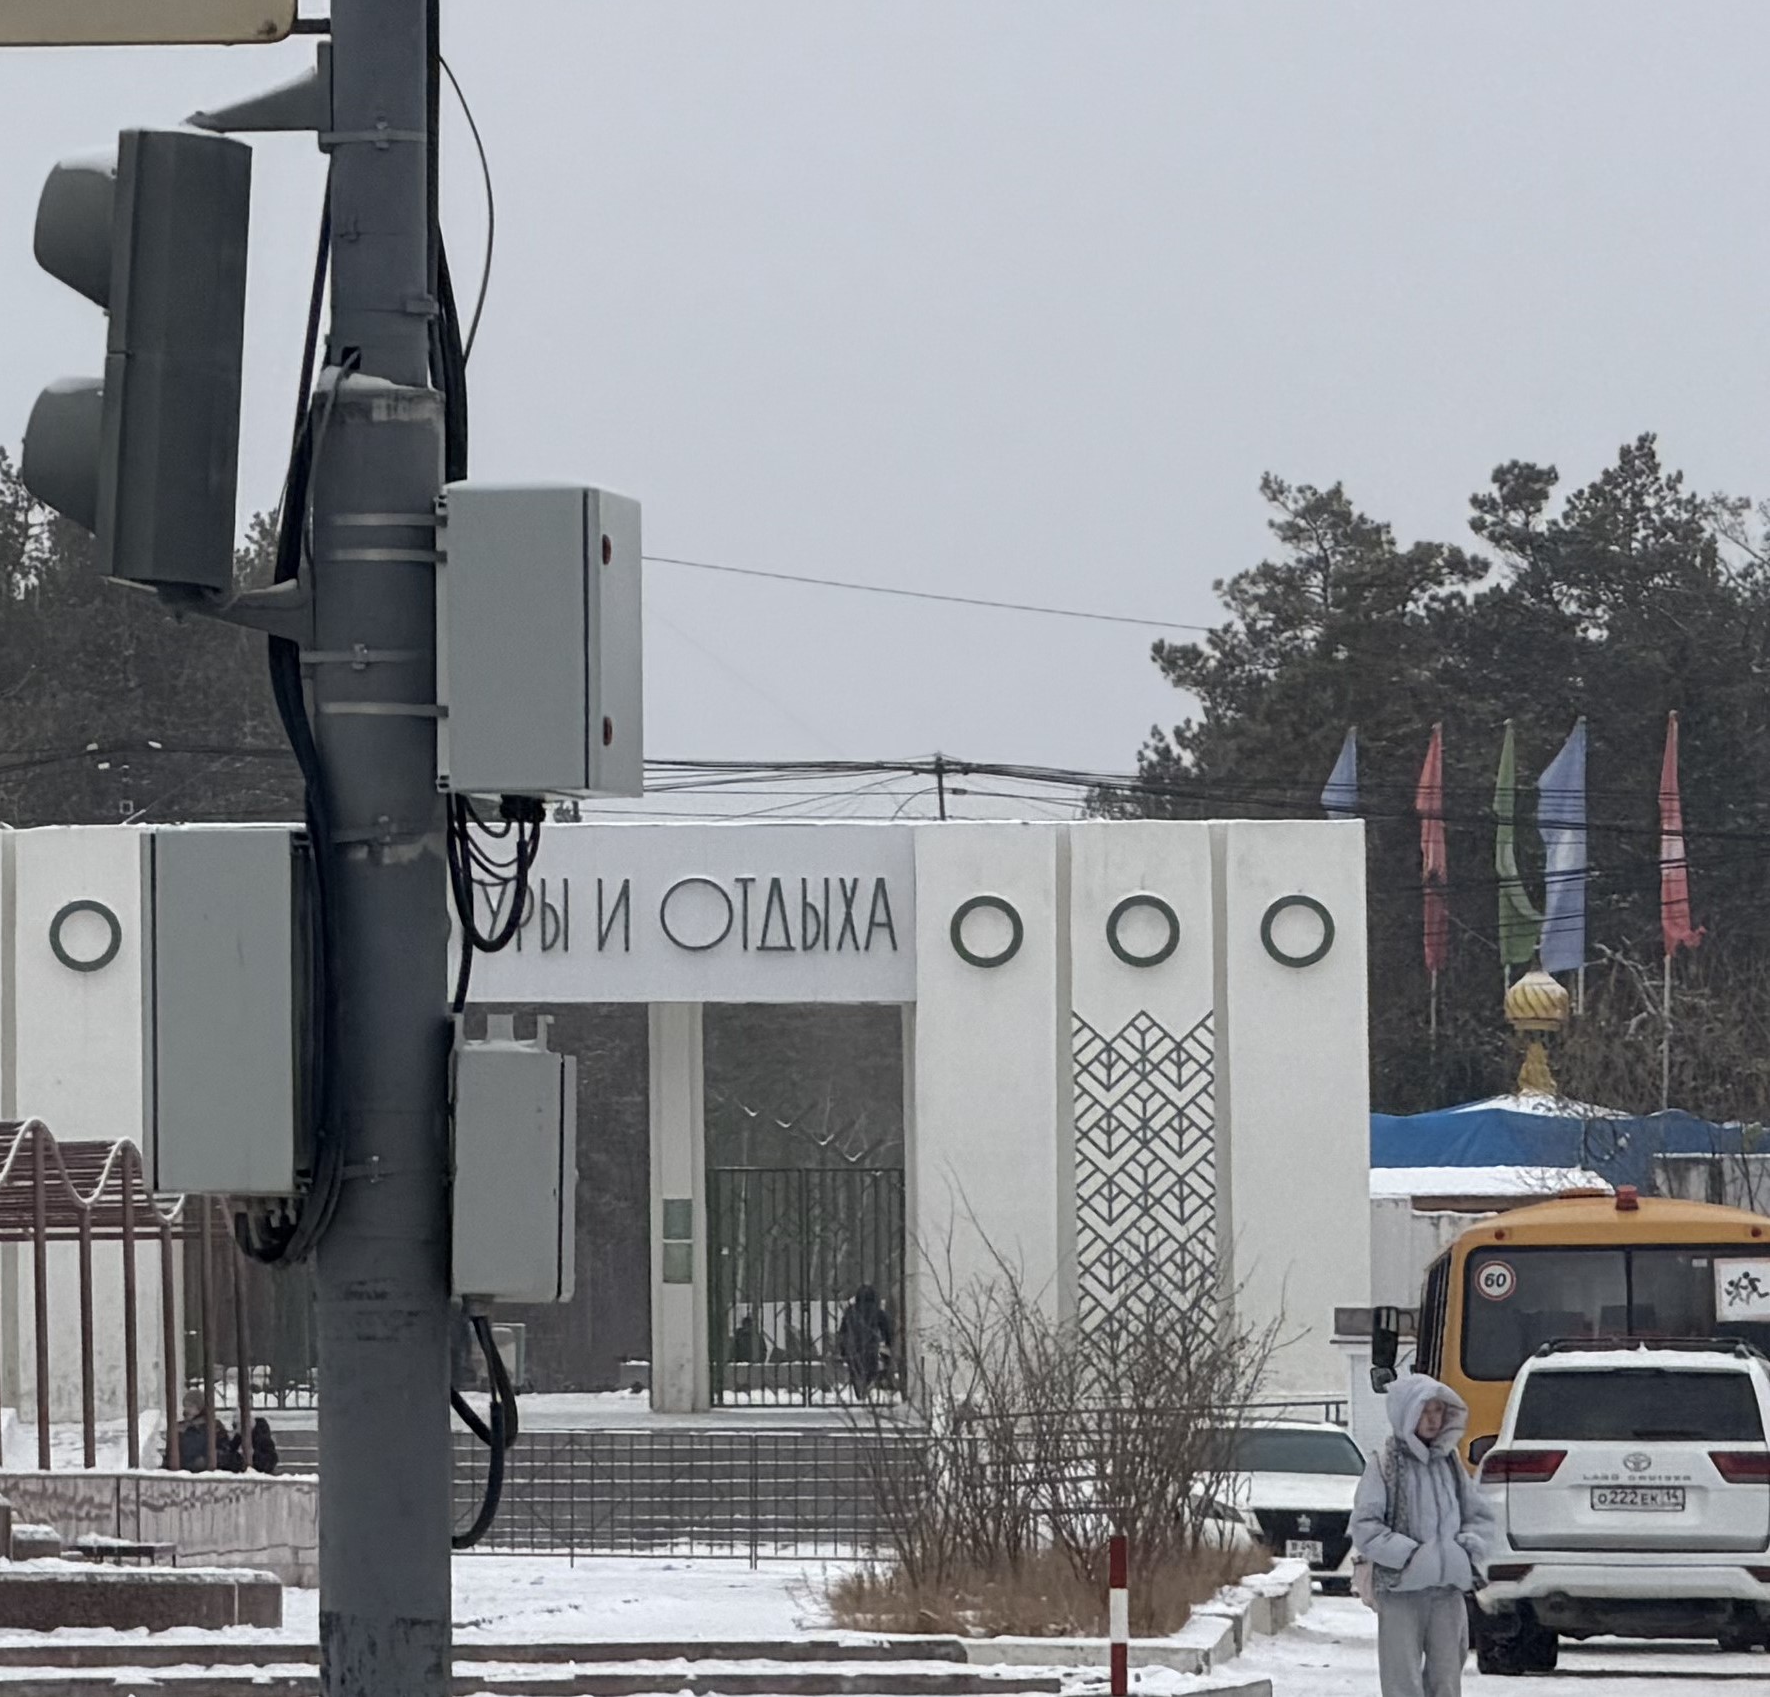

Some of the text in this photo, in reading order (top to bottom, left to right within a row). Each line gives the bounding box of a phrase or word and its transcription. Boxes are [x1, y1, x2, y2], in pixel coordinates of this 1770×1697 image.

[596, 878, 631, 952] И
[659, 877, 898, 952] ОТДЫХА
[1484, 1272, 1507, 1289] 60
